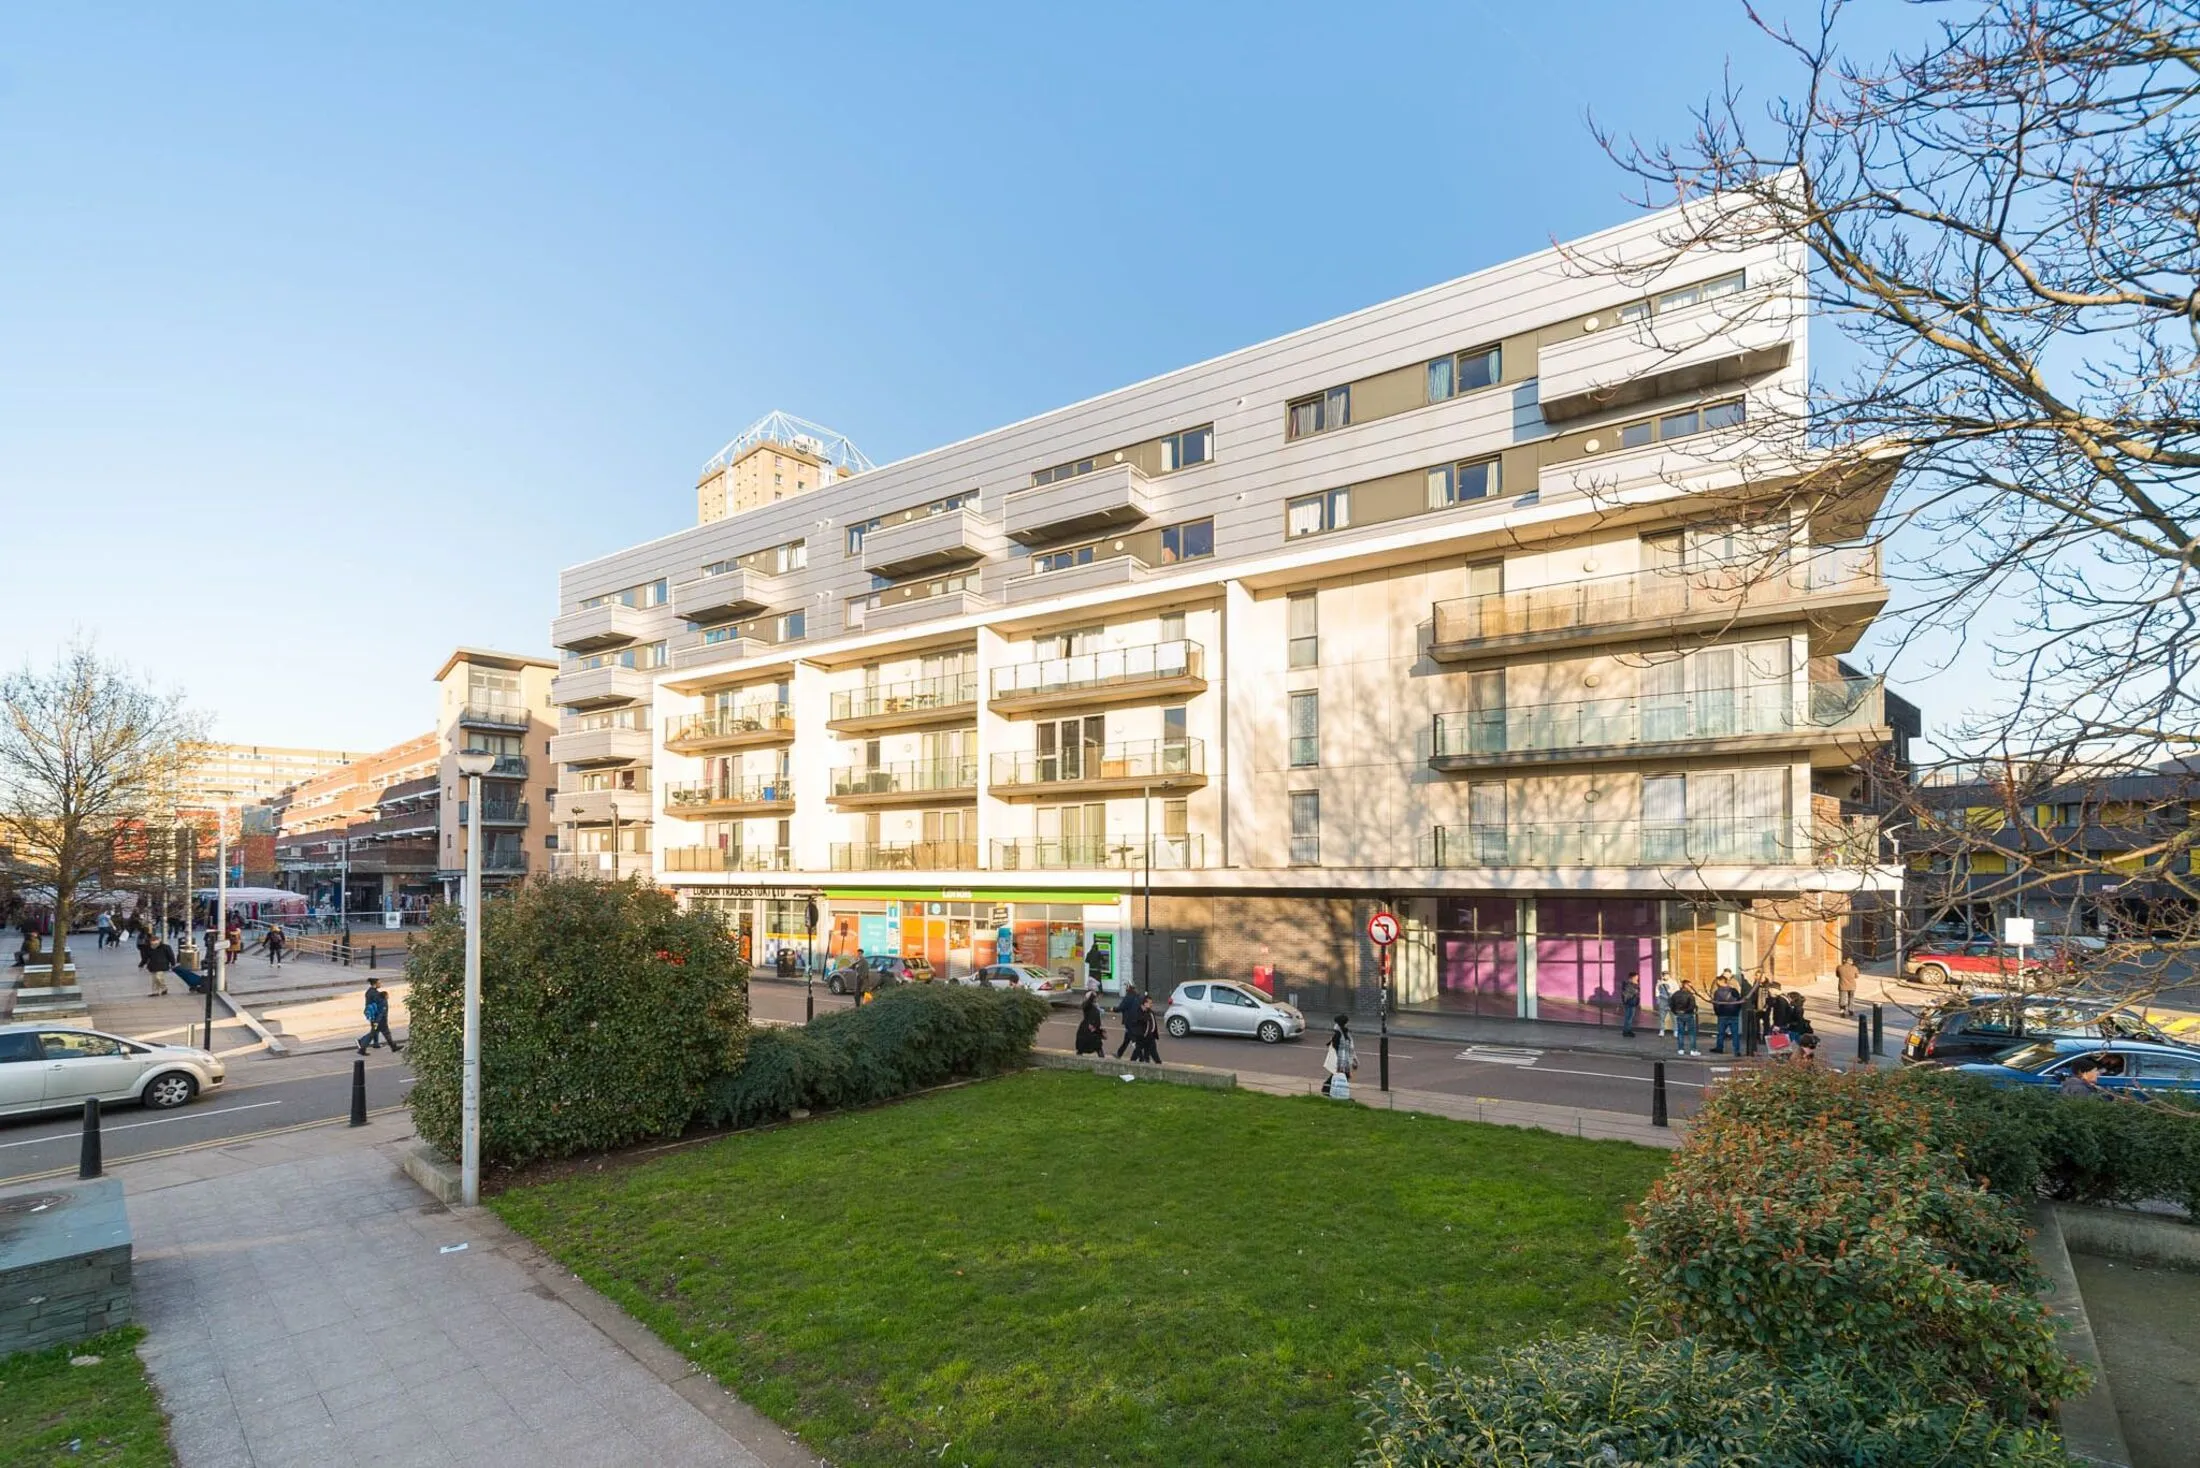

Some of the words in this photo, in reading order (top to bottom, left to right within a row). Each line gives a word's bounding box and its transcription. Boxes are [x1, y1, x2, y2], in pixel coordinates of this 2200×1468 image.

[721, 887, 753, 897] TRADERS
[754, 887, 771, 897] (UK)
[772, 887, 786, 897] LTD
